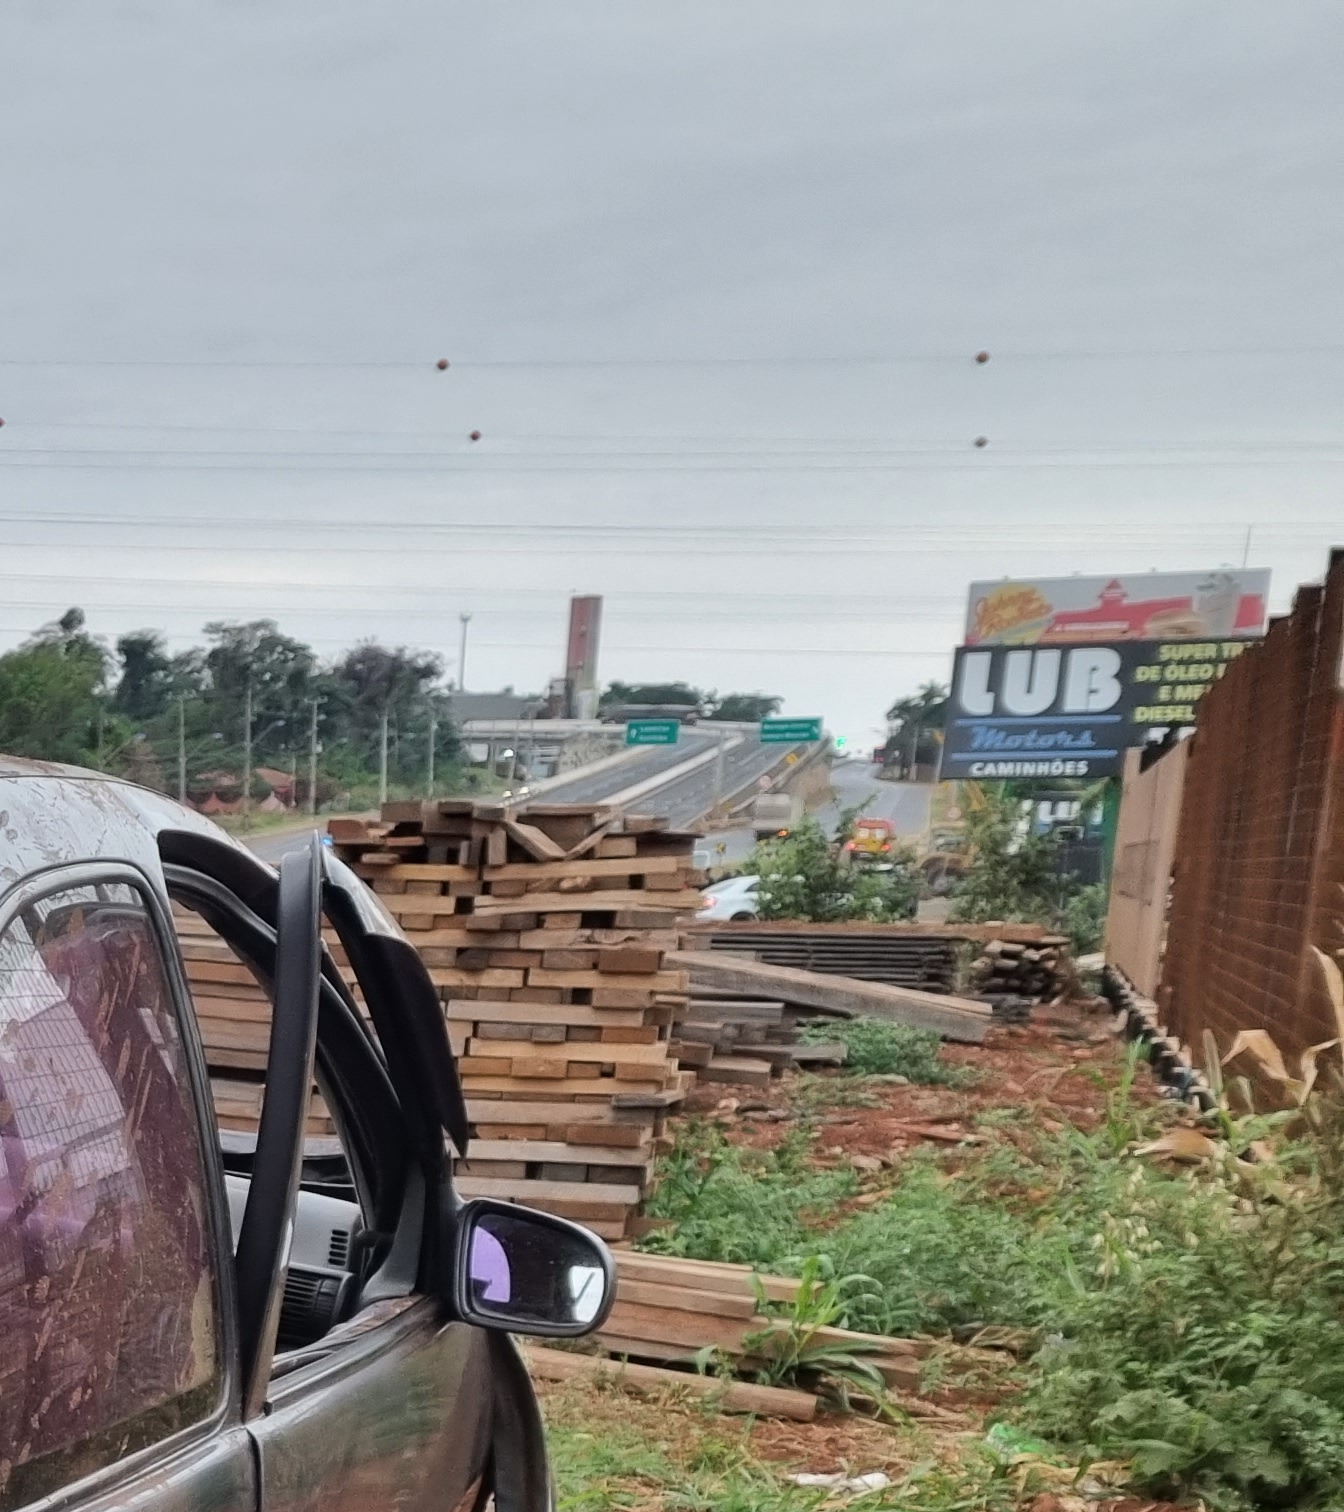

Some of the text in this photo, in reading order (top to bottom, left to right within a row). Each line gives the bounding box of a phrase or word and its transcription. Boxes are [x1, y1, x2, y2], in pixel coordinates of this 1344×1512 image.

[1158, 643, 1217, 661] SUPER
[1134, 664, 1162, 682] DE
[1163, 660, 1214, 681] ÓLEO
[960, 647, 1123, 716] LUB
[1134, 704, 1197, 722] DIESEL
[970, 726, 1097, 749] Motors
[971, 758, 1089, 777] CAMINHÕES
